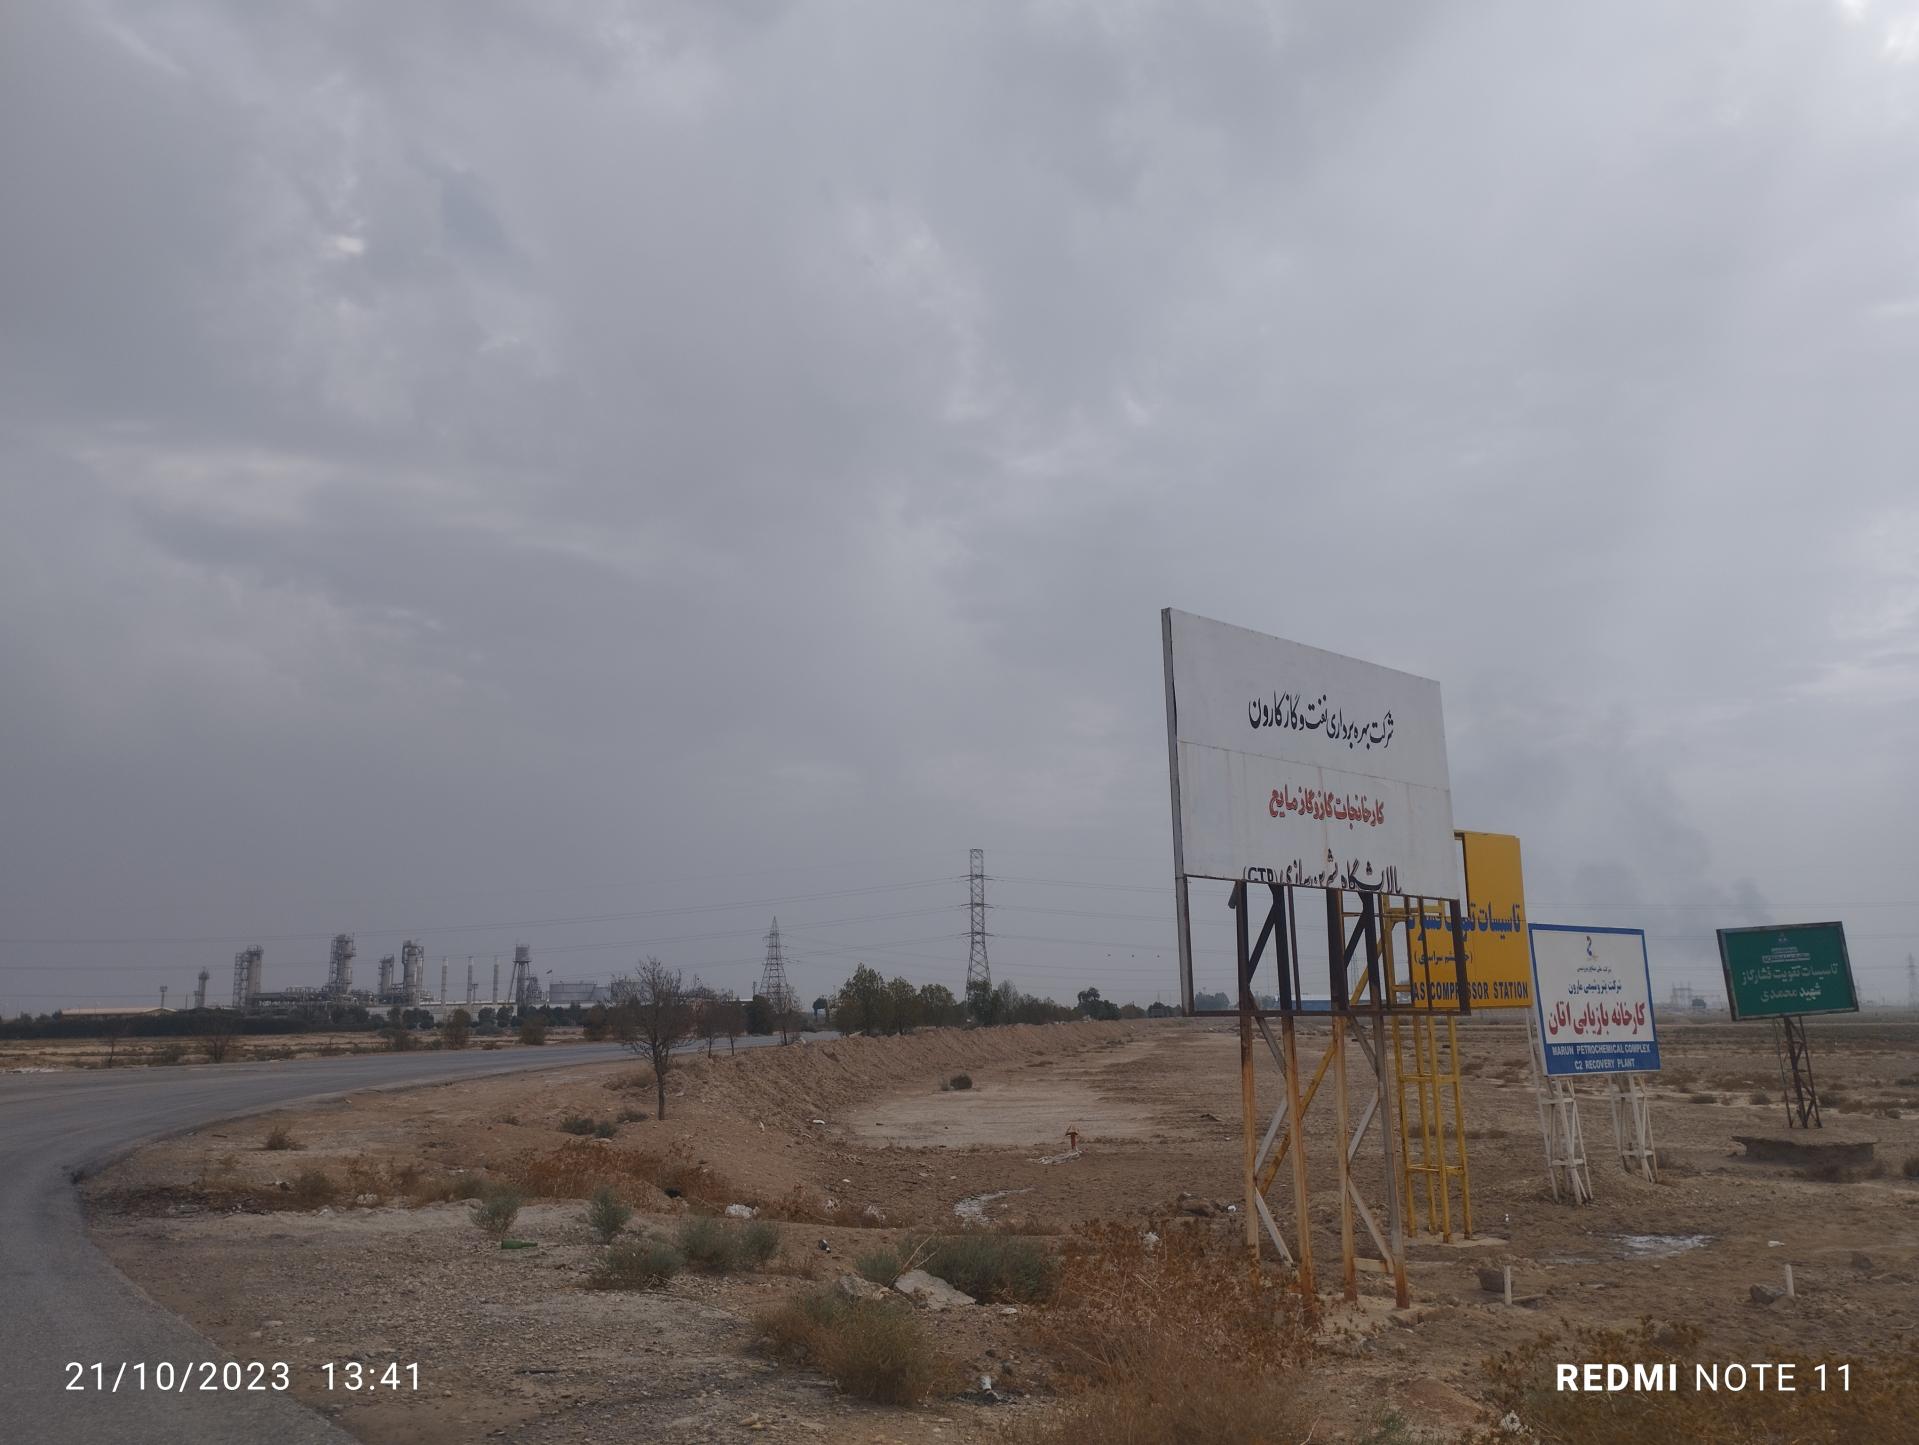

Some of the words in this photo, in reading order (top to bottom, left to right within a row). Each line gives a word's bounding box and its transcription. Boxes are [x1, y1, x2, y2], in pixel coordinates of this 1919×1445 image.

[1248, 689, 1287, 729] کارون
[1284, 692, 1300, 730] گاز
[1304, 694, 1328, 730] نفت
[1369, 709, 1394, 749] شرکت
[1268, 783, 1298, 818] مایع
[1608, 979, 1622, 994] شرکت
[1802, 963, 1838, 981] تاسیسات
[1493, 981, 1529, 1000] STATION
[1760, 988, 1798, 1002] محمدی
[1799, 982, 1821, 1001] شهید
[1548, 1000, 1571, 1035] اتان
[1573, 1001, 1609, 1035] بازیابی
[1612, 1001, 1646, 1035] کارخانه
[1574, 1060, 1584, 1070] C2
[1585, 1059, 1615, 1070] RECOVERY
[1617, 1058, 1635, 1069] PLANT
[1576, 1044, 1624, 1055] PETROCHEMICAL
[1624, 1043, 1650, 1054] COMPLEX
